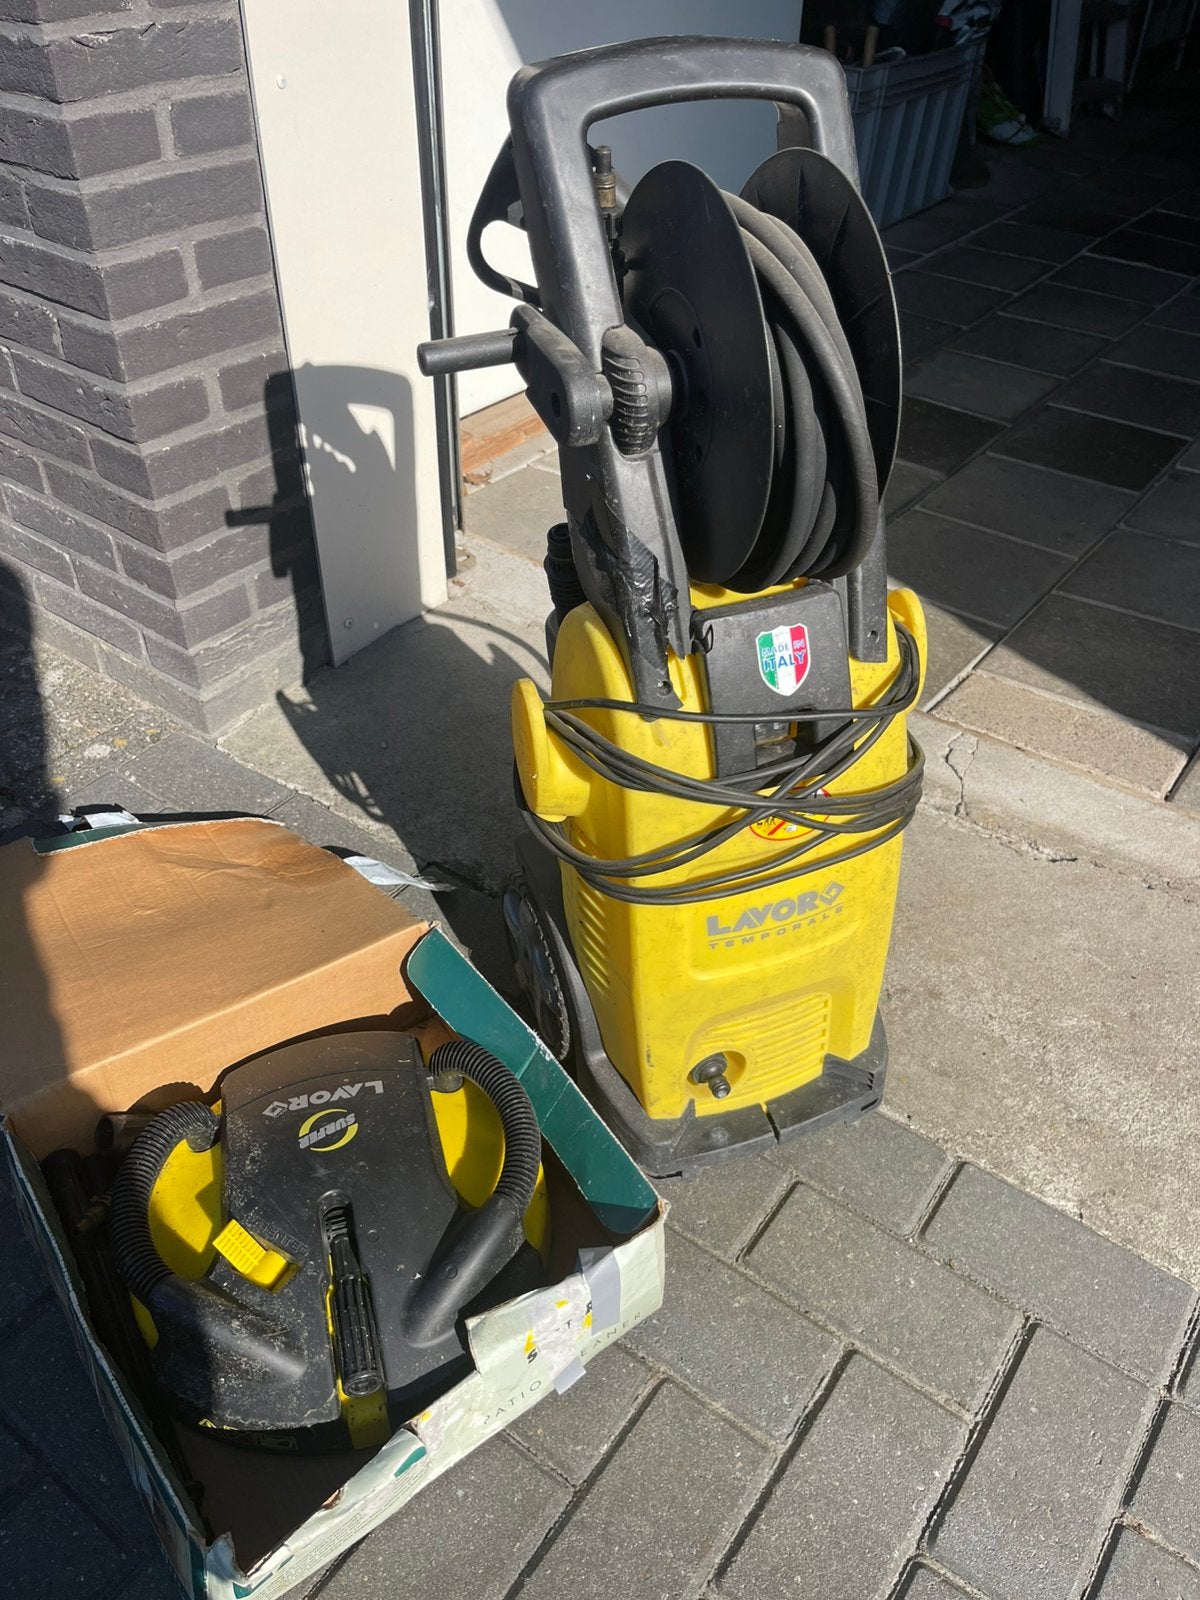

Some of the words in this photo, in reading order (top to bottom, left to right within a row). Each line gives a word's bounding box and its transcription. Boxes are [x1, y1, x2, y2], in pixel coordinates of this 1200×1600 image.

[762, 643, 790, 657] MADE
[793, 639, 805, 649] IN
[764, 650, 806, 672] ITALY
[708, 904, 844, 950] TEMPORALE
[298, 1112, 356, 1150] SURFER
[580, 1312, 641, 1357] EANER
